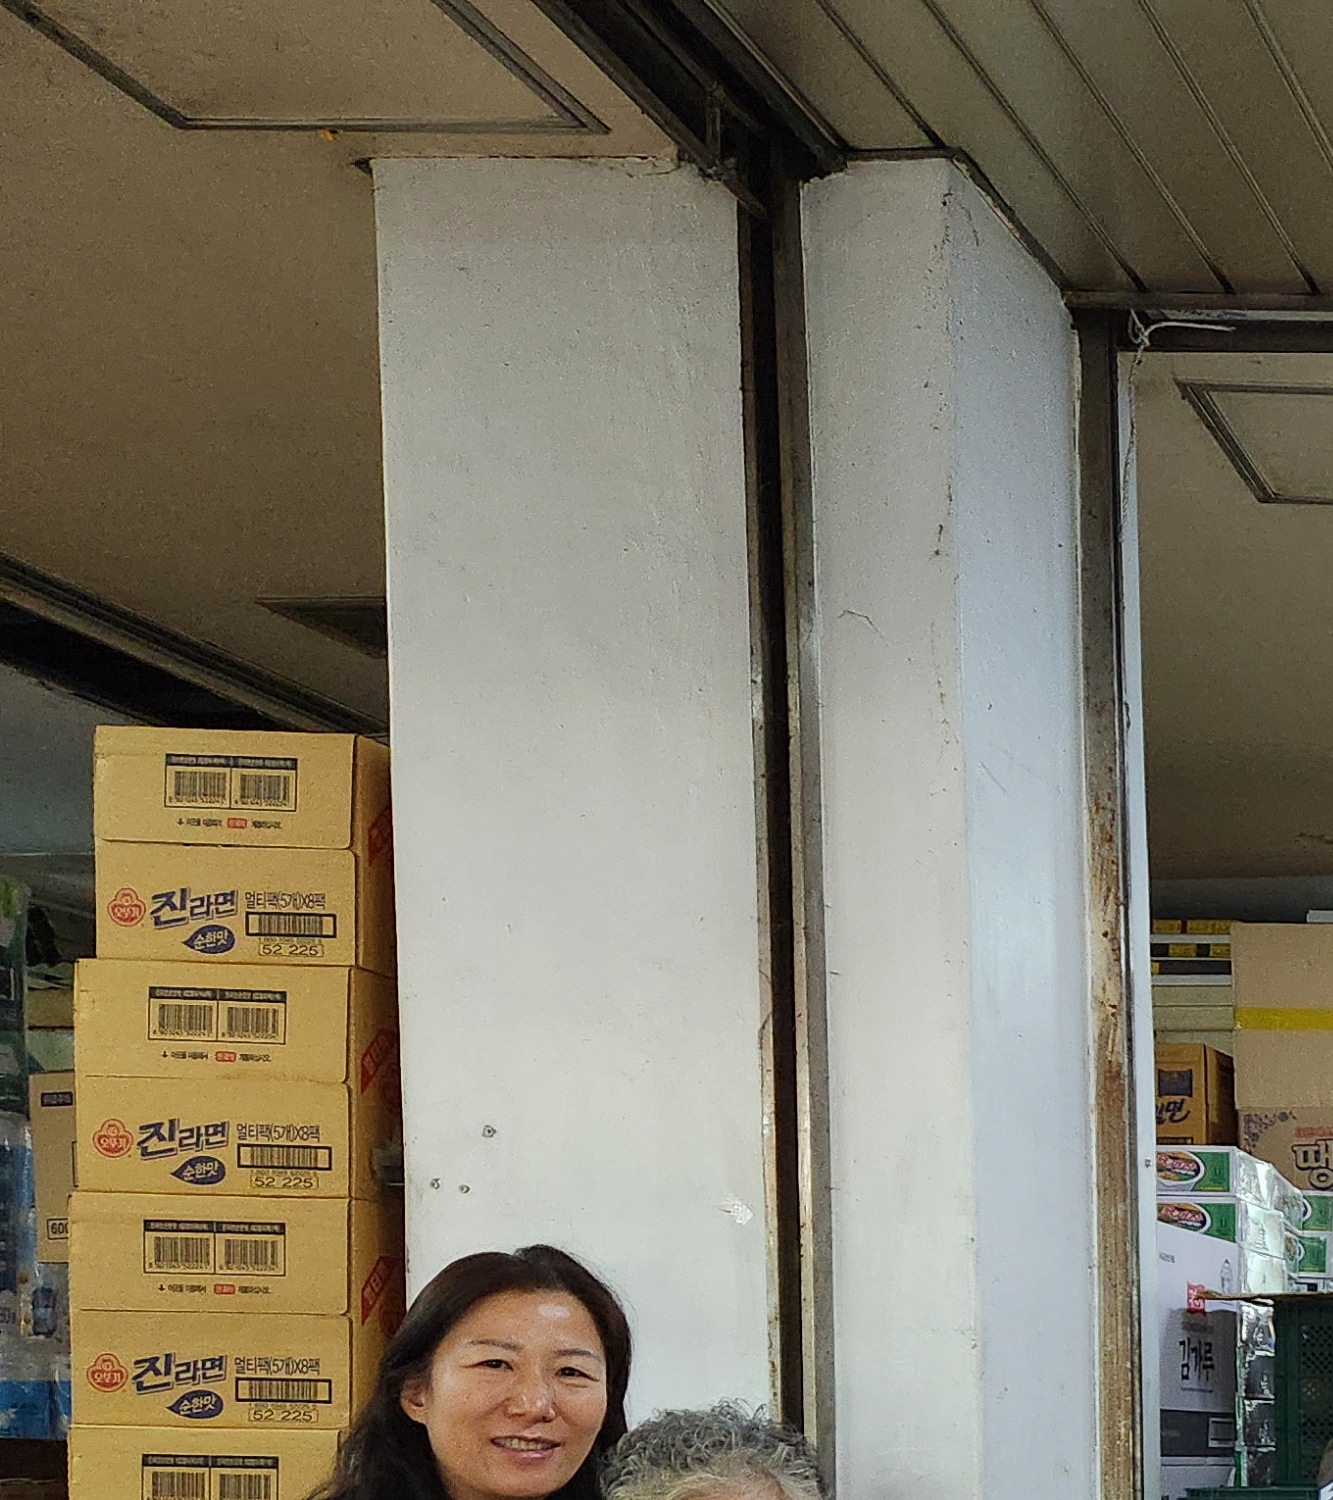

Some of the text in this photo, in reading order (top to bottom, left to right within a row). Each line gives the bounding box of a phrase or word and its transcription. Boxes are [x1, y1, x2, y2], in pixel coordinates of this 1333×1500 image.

[150, 887, 238, 928] 진라면
[138, 1119, 230, 1159] 진라면
[181, 1160, 218, 1180] 순한맛
[254, 1176, 313, 1188] 52 225
[134, 1354, 227, 1393] 진라면
[179, 1392, 217, 1414] 순한맛
[253, 1409, 313, 1421] 52 225
